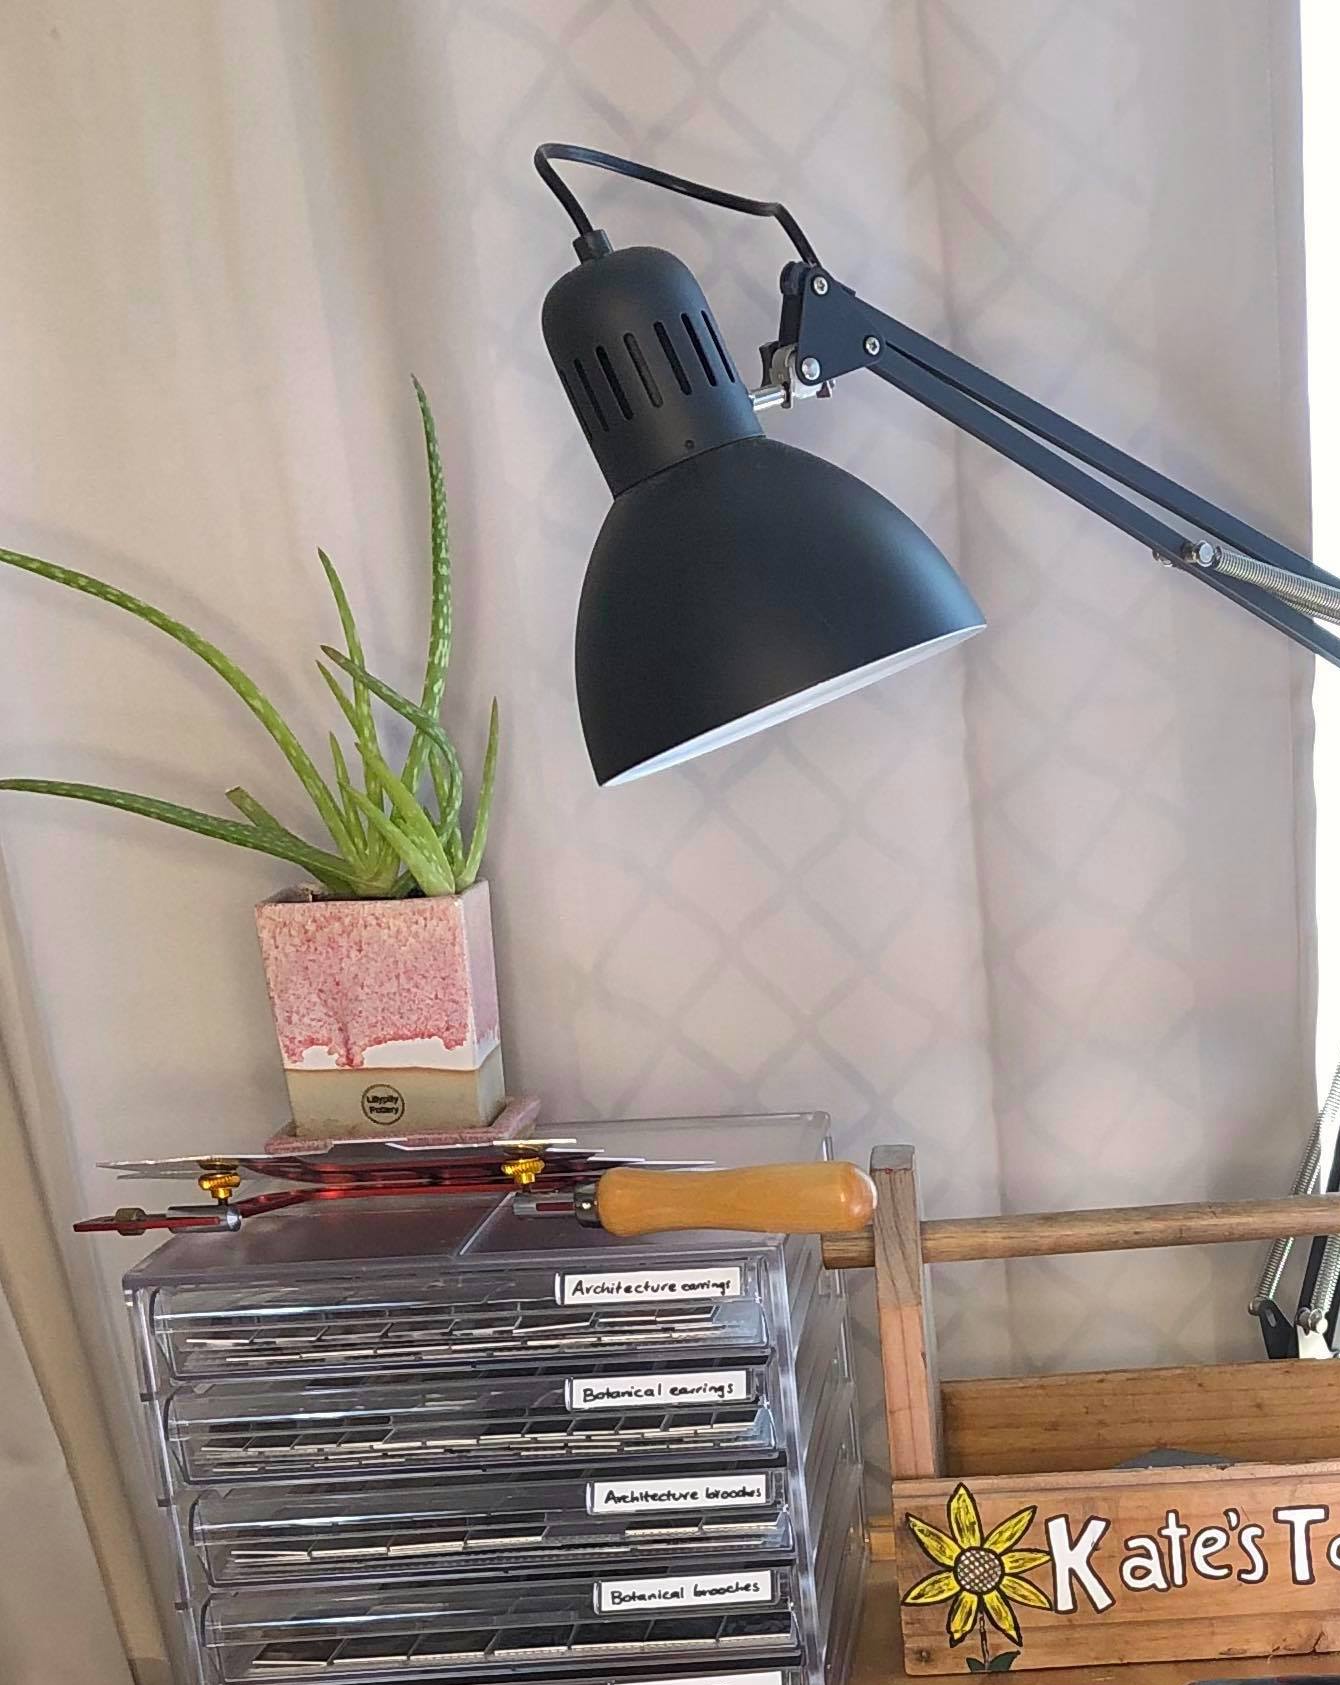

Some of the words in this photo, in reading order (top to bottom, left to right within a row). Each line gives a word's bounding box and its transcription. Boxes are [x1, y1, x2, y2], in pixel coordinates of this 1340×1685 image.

[571, 1280, 677, 1296] Architecture
[583, 1383, 662, 1403] Botanical
[669, 1383, 734, 1398] earrings
[604, 1489, 699, 1504] Architecture
[1044, 1506, 1269, 1614] Kate's
[611, 1587, 684, 1605] Botanical
